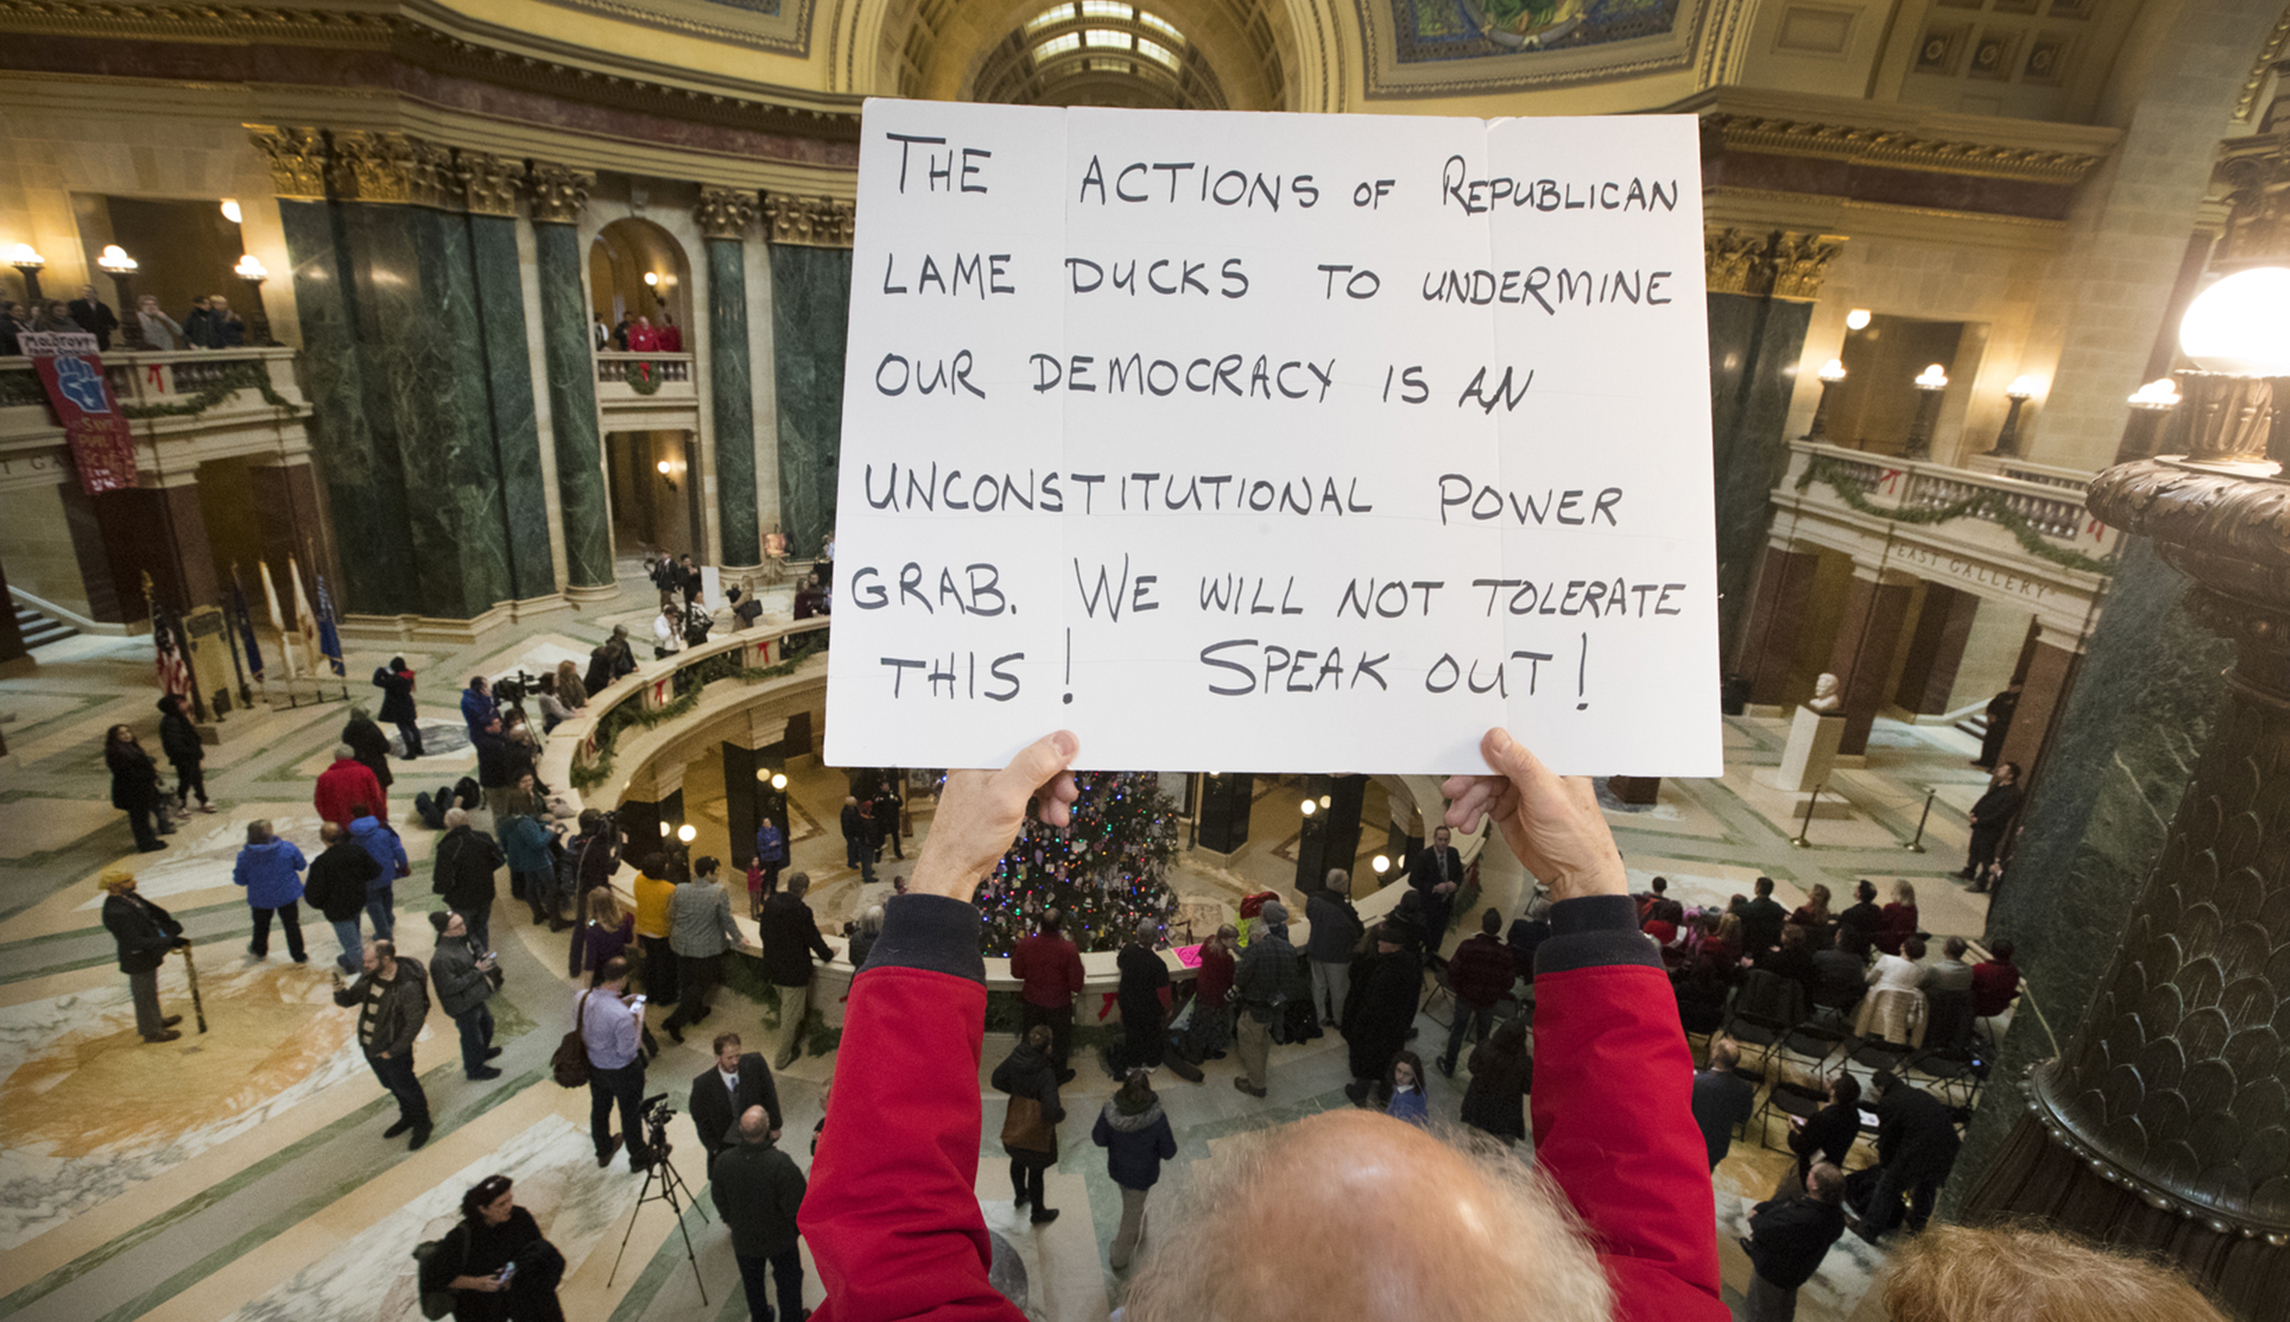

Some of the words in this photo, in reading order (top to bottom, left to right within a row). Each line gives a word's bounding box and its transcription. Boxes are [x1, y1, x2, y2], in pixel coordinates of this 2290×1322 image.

[886, 132, 992, 194] THE
[1080, 154, 1319, 208] ACTIONS
[1353, 179, 1396, 210] OF
[1443, 154, 1678, 216] REPUBLICAN
[883, 253, 1015, 300] LAME
[1064, 257, 1249, 299] DUCKS
[1317, 264, 1380, 299] TO
[1422, 266, 1672, 316] UNDERMINE
[875, 349, 986, 400] OUR
[1029, 352, 1336, 403] DEMOCRACY
[1383, 365, 1429, 404] IS
[1458, 366, 1534, 415] AN
[865, 462, 1373, 516] UNCONSTITUTIONAL
[1438, 473, 1623, 527] POWER
[851, 562, 1017, 617] GRAB.
[1074, 553, 1159, 623] WE
[1200, 573, 1304, 615] WILL
[1337, 578, 1445, 620] NOT
[1472, 577, 1686, 618] TOLERATE
[1897, 543, 1940, 566] EAST
[1949, 558, 2049, 599] GALLERY
[1200, 639, 1390, 696] SPEAK
